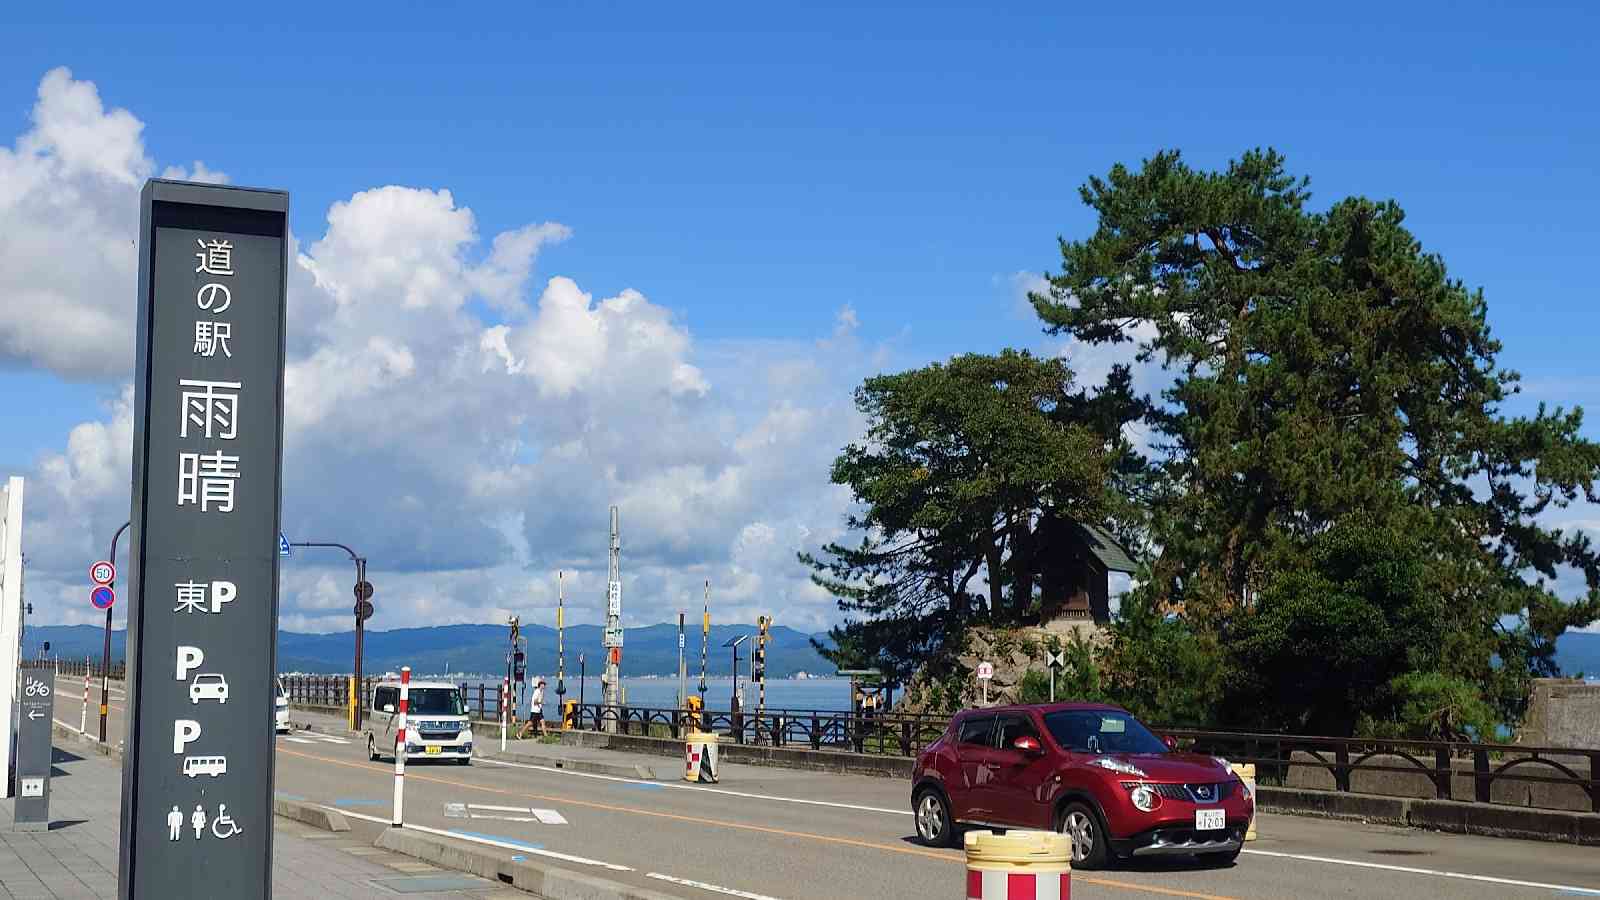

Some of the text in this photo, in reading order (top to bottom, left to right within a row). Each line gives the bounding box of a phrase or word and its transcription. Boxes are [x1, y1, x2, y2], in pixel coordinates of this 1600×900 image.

[177, 238, 242, 513] 道の駅 雨晴
[96, 567, 110, 579] 50
[176, 645, 205, 681] P
[173, 719, 202, 754] P
